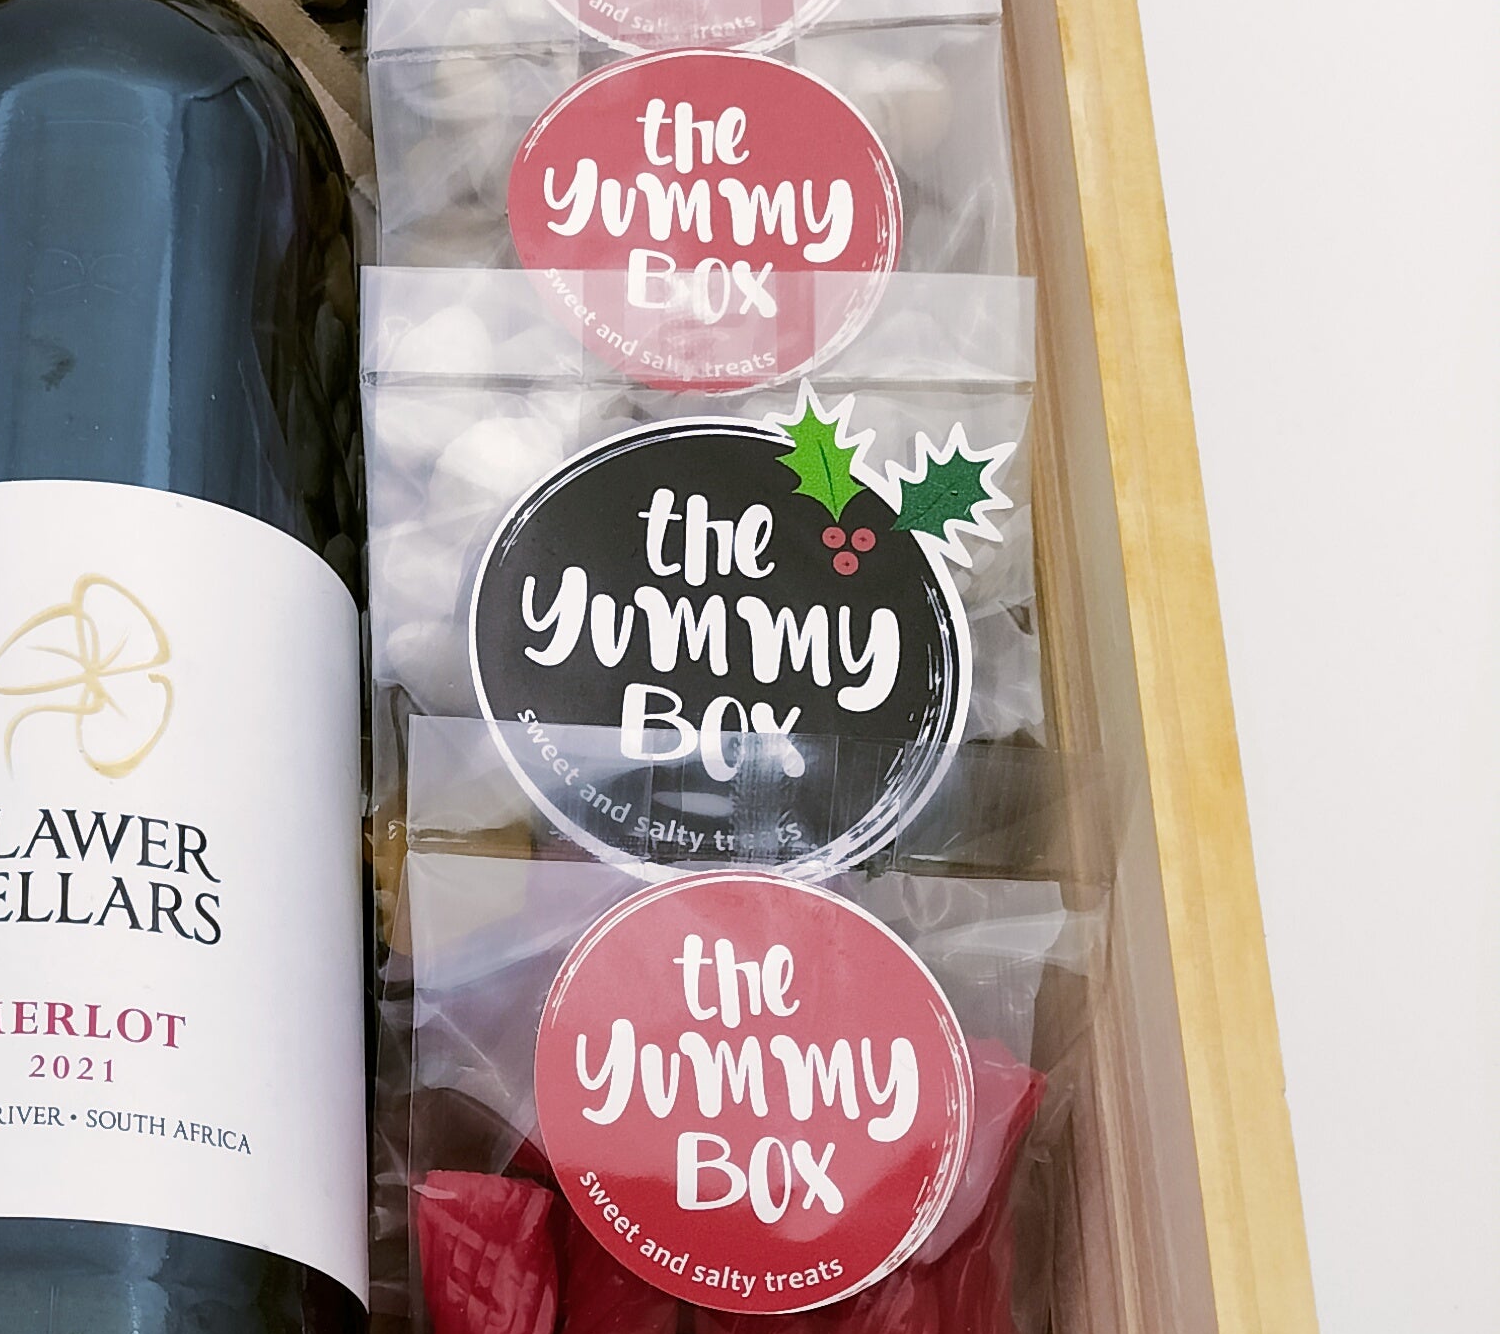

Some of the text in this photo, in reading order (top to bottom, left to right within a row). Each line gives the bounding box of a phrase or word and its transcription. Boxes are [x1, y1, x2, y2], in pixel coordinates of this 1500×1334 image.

[635, 97, 750, 174] the
[543, 157, 855, 263] yummy
[543, 267, 597, 327] sweet
[596, 323, 639, 357] and
[704, 350, 776, 378] treats
[638, 487, 776, 587] the
[521, 565, 901, 714] yummy
[518, 708, 580, 786] sweet
[579, 782, 632, 824] and
[633, 816, 705, 853] salty
[672, 933, 801, 1029] the
[28, 1054, 115, 1084] 2021
[575, 1018, 920, 1143] yummy
[86, 1109, 167, 1137] SOUTH
[172, 1120, 252, 1156] AFRICA
[579, 1170, 845, 1299] sweet and salty treats
